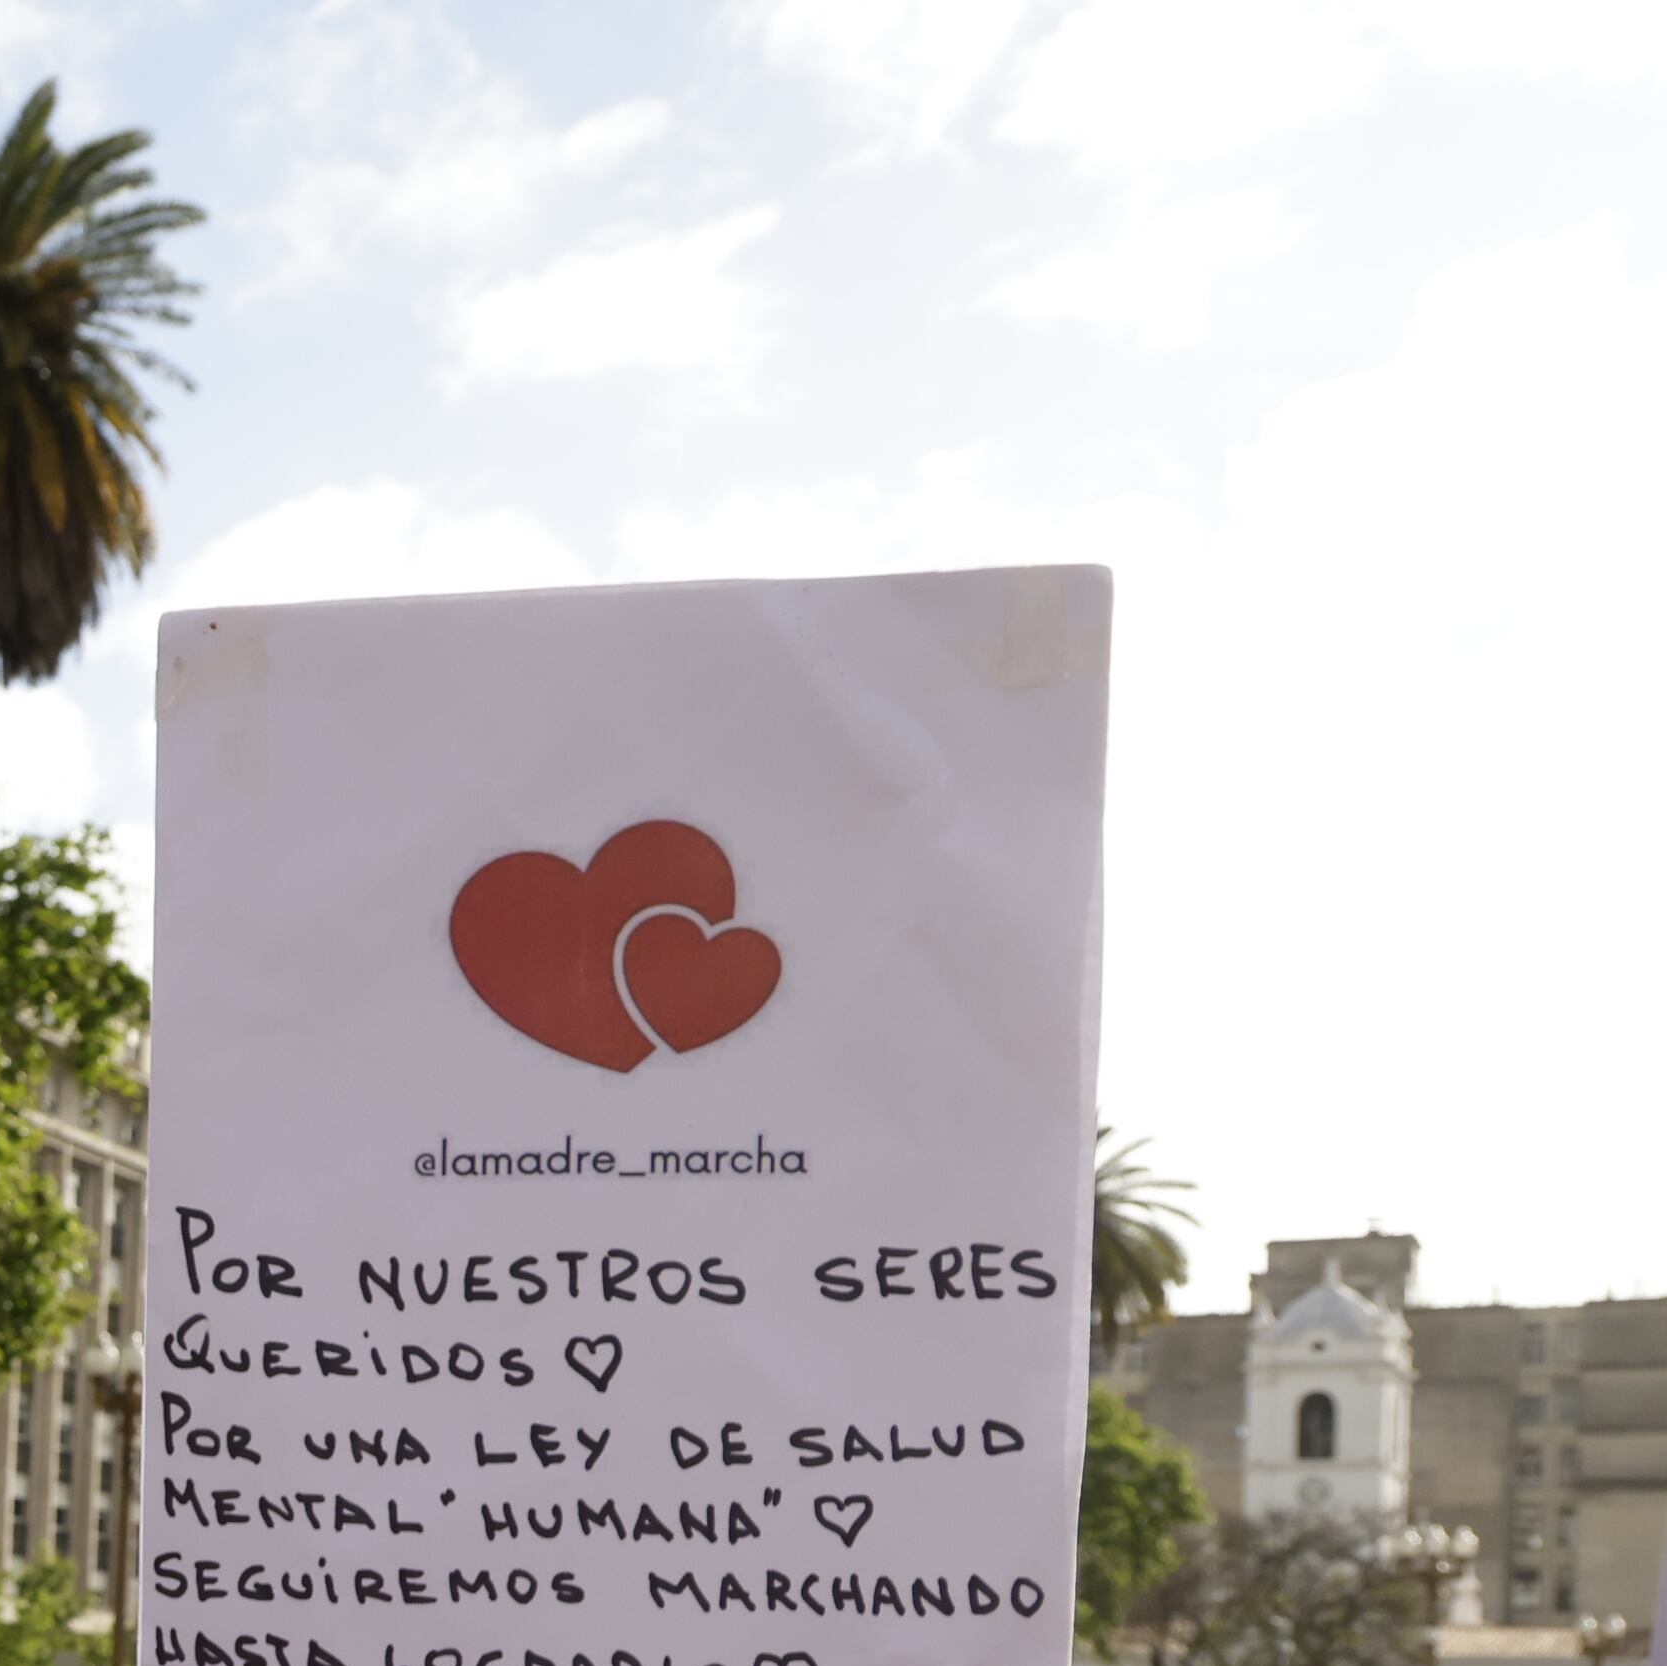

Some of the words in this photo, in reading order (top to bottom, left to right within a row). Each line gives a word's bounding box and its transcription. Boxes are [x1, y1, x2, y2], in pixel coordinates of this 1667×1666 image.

[413, 1132, 809, 1179] @lamadre_marcha
[174, 1205, 304, 1300] POR
[357, 1247, 747, 1313] NUESTROS
[813, 1242, 1058, 1304] SERES
[159, 1391, 263, 1466] POR
[302, 1426, 432, 1468] UNA
[473, 1422, 612, 1472] LEY
[669, 1421, 754, 1471] DE
[788, 1418, 1026, 1469] SALUD
[162, 1476, 425, 1536] MENTAL
[647, 1568, 1046, 1619] MARCHANDO
